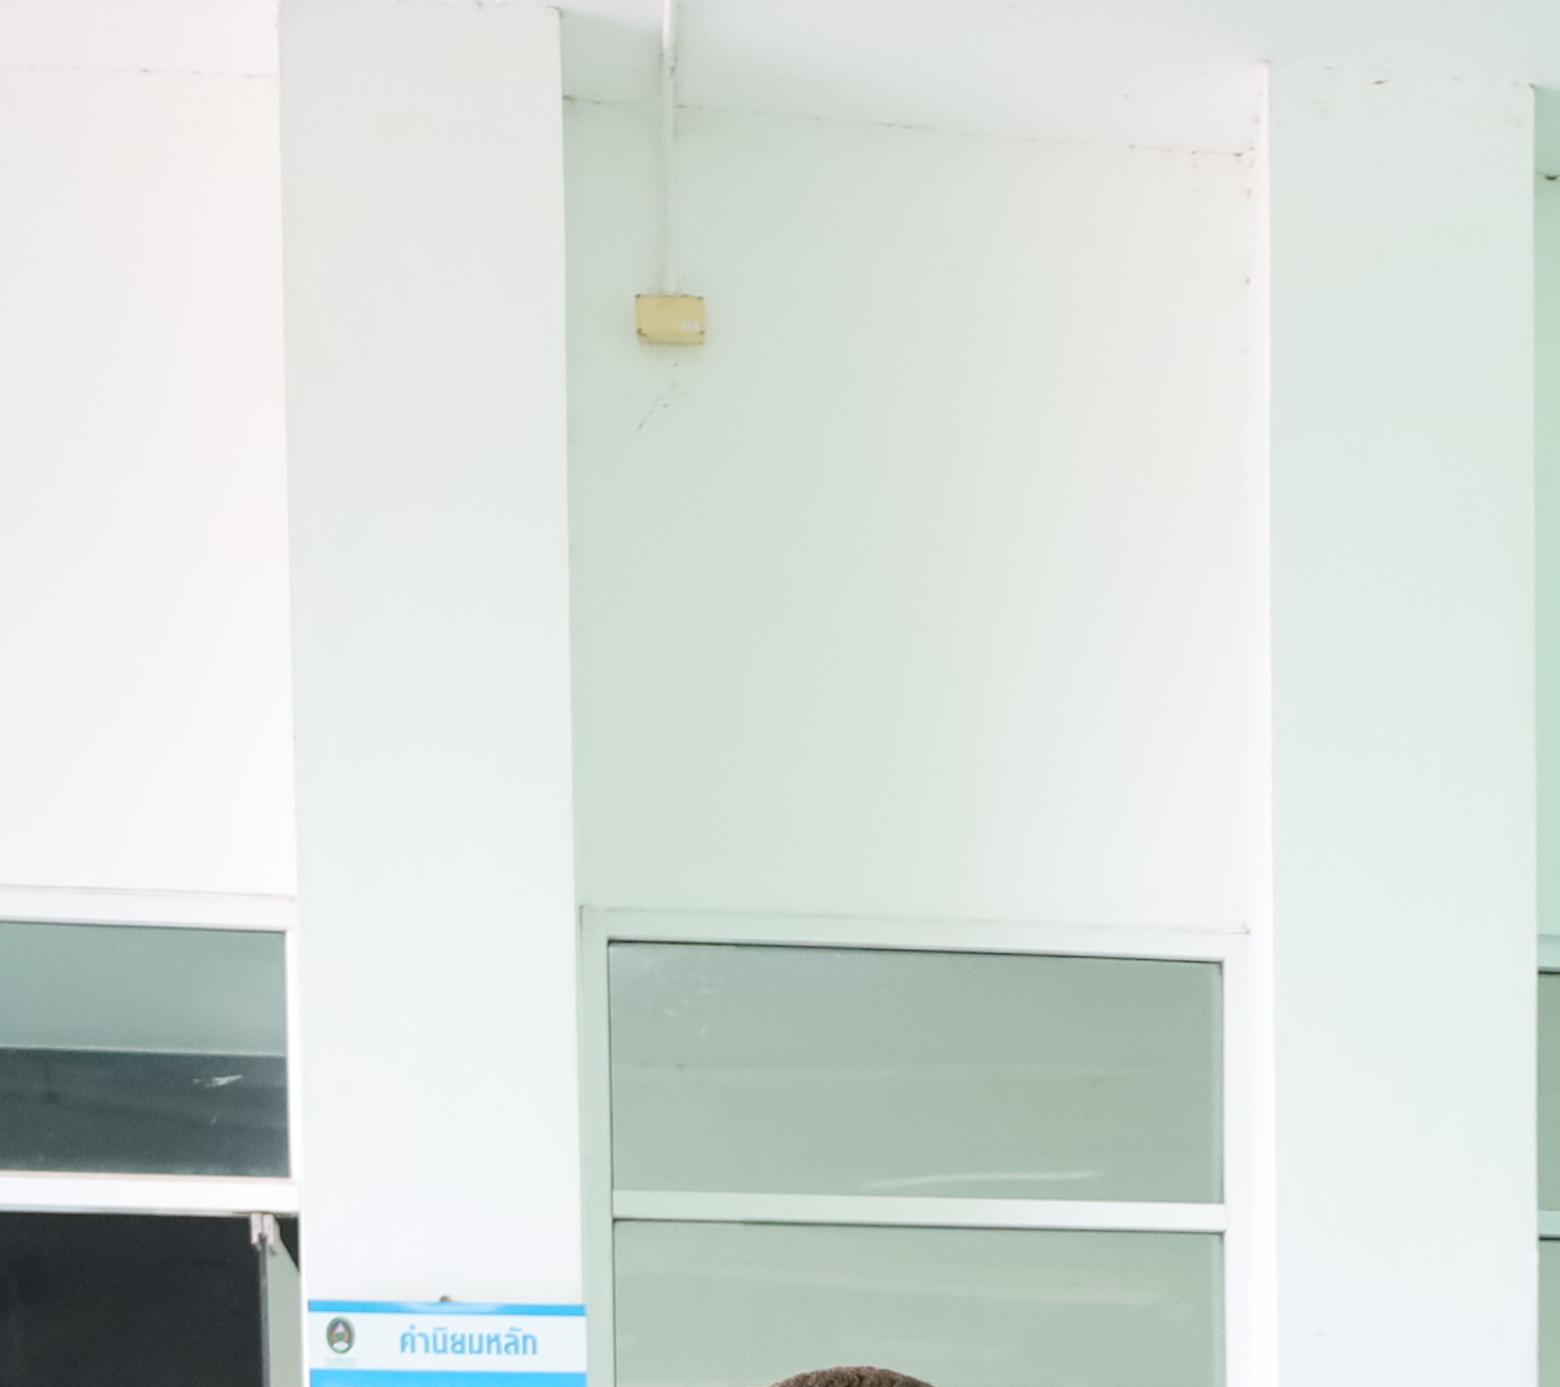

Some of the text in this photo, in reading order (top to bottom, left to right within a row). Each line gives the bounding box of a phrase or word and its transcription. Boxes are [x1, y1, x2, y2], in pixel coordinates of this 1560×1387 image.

[399, 1324, 539, 1356] ค่านิยมหลัก
